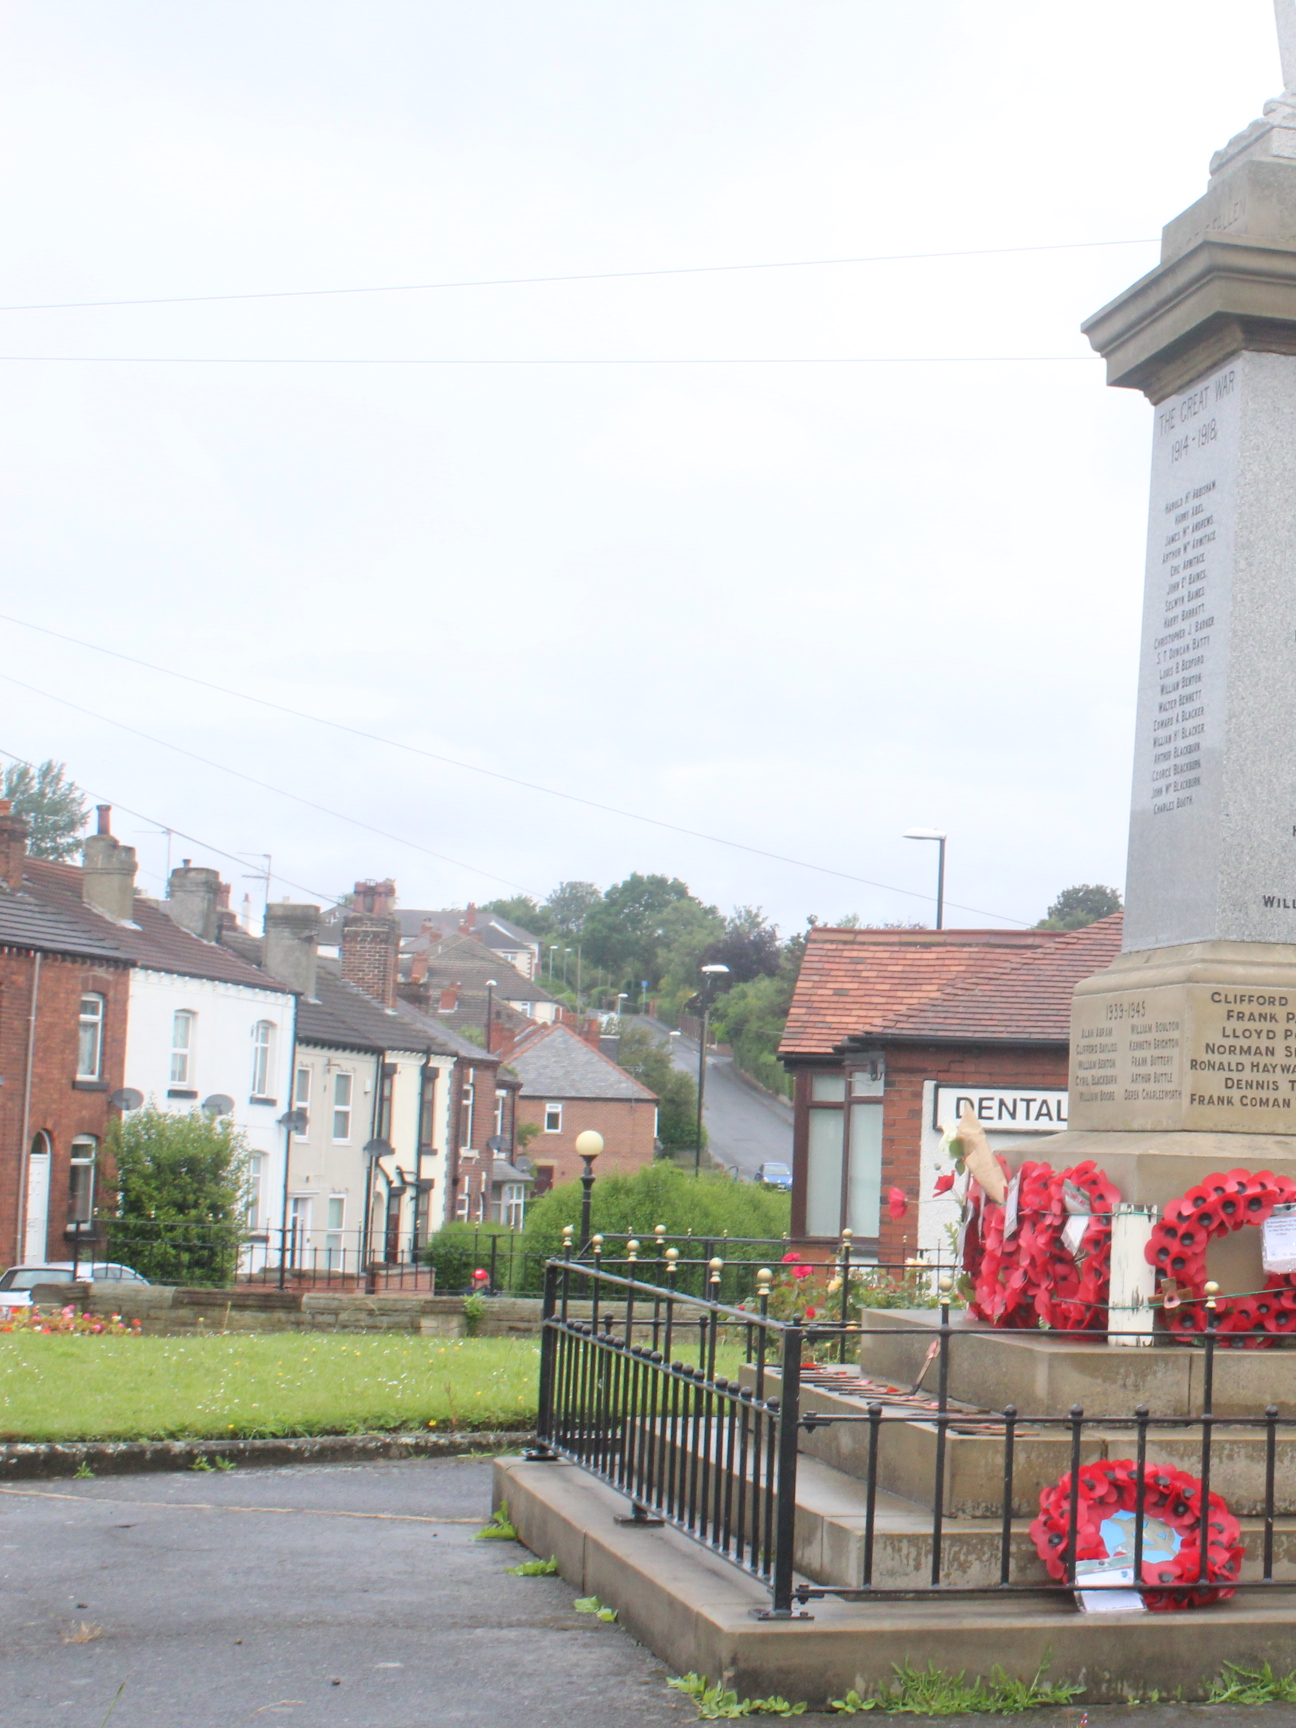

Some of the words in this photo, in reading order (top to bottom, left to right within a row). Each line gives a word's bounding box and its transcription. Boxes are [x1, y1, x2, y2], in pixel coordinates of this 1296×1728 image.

[1160, 407, 1176, 436] THE
[1216, 371, 1235, 402] WAR
[1210, 991, 1289, 1006] CLIFFORD
[1106, 1001, 1145, 1020] 1939-1945
[1226, 1009, 1279, 1023] FRANK
[1222, 1026, 1276, 1040] LLOYD
[1204, 1042, 1275, 1056] NORMAN
[1189, 1058, 1245, 1072] RONALD
[1224, 1077, 1279, 1091] DENNIS
[1189, 1092, 1235, 1106] FRANK
[956, 1097, 1068, 1121] DENTAL
